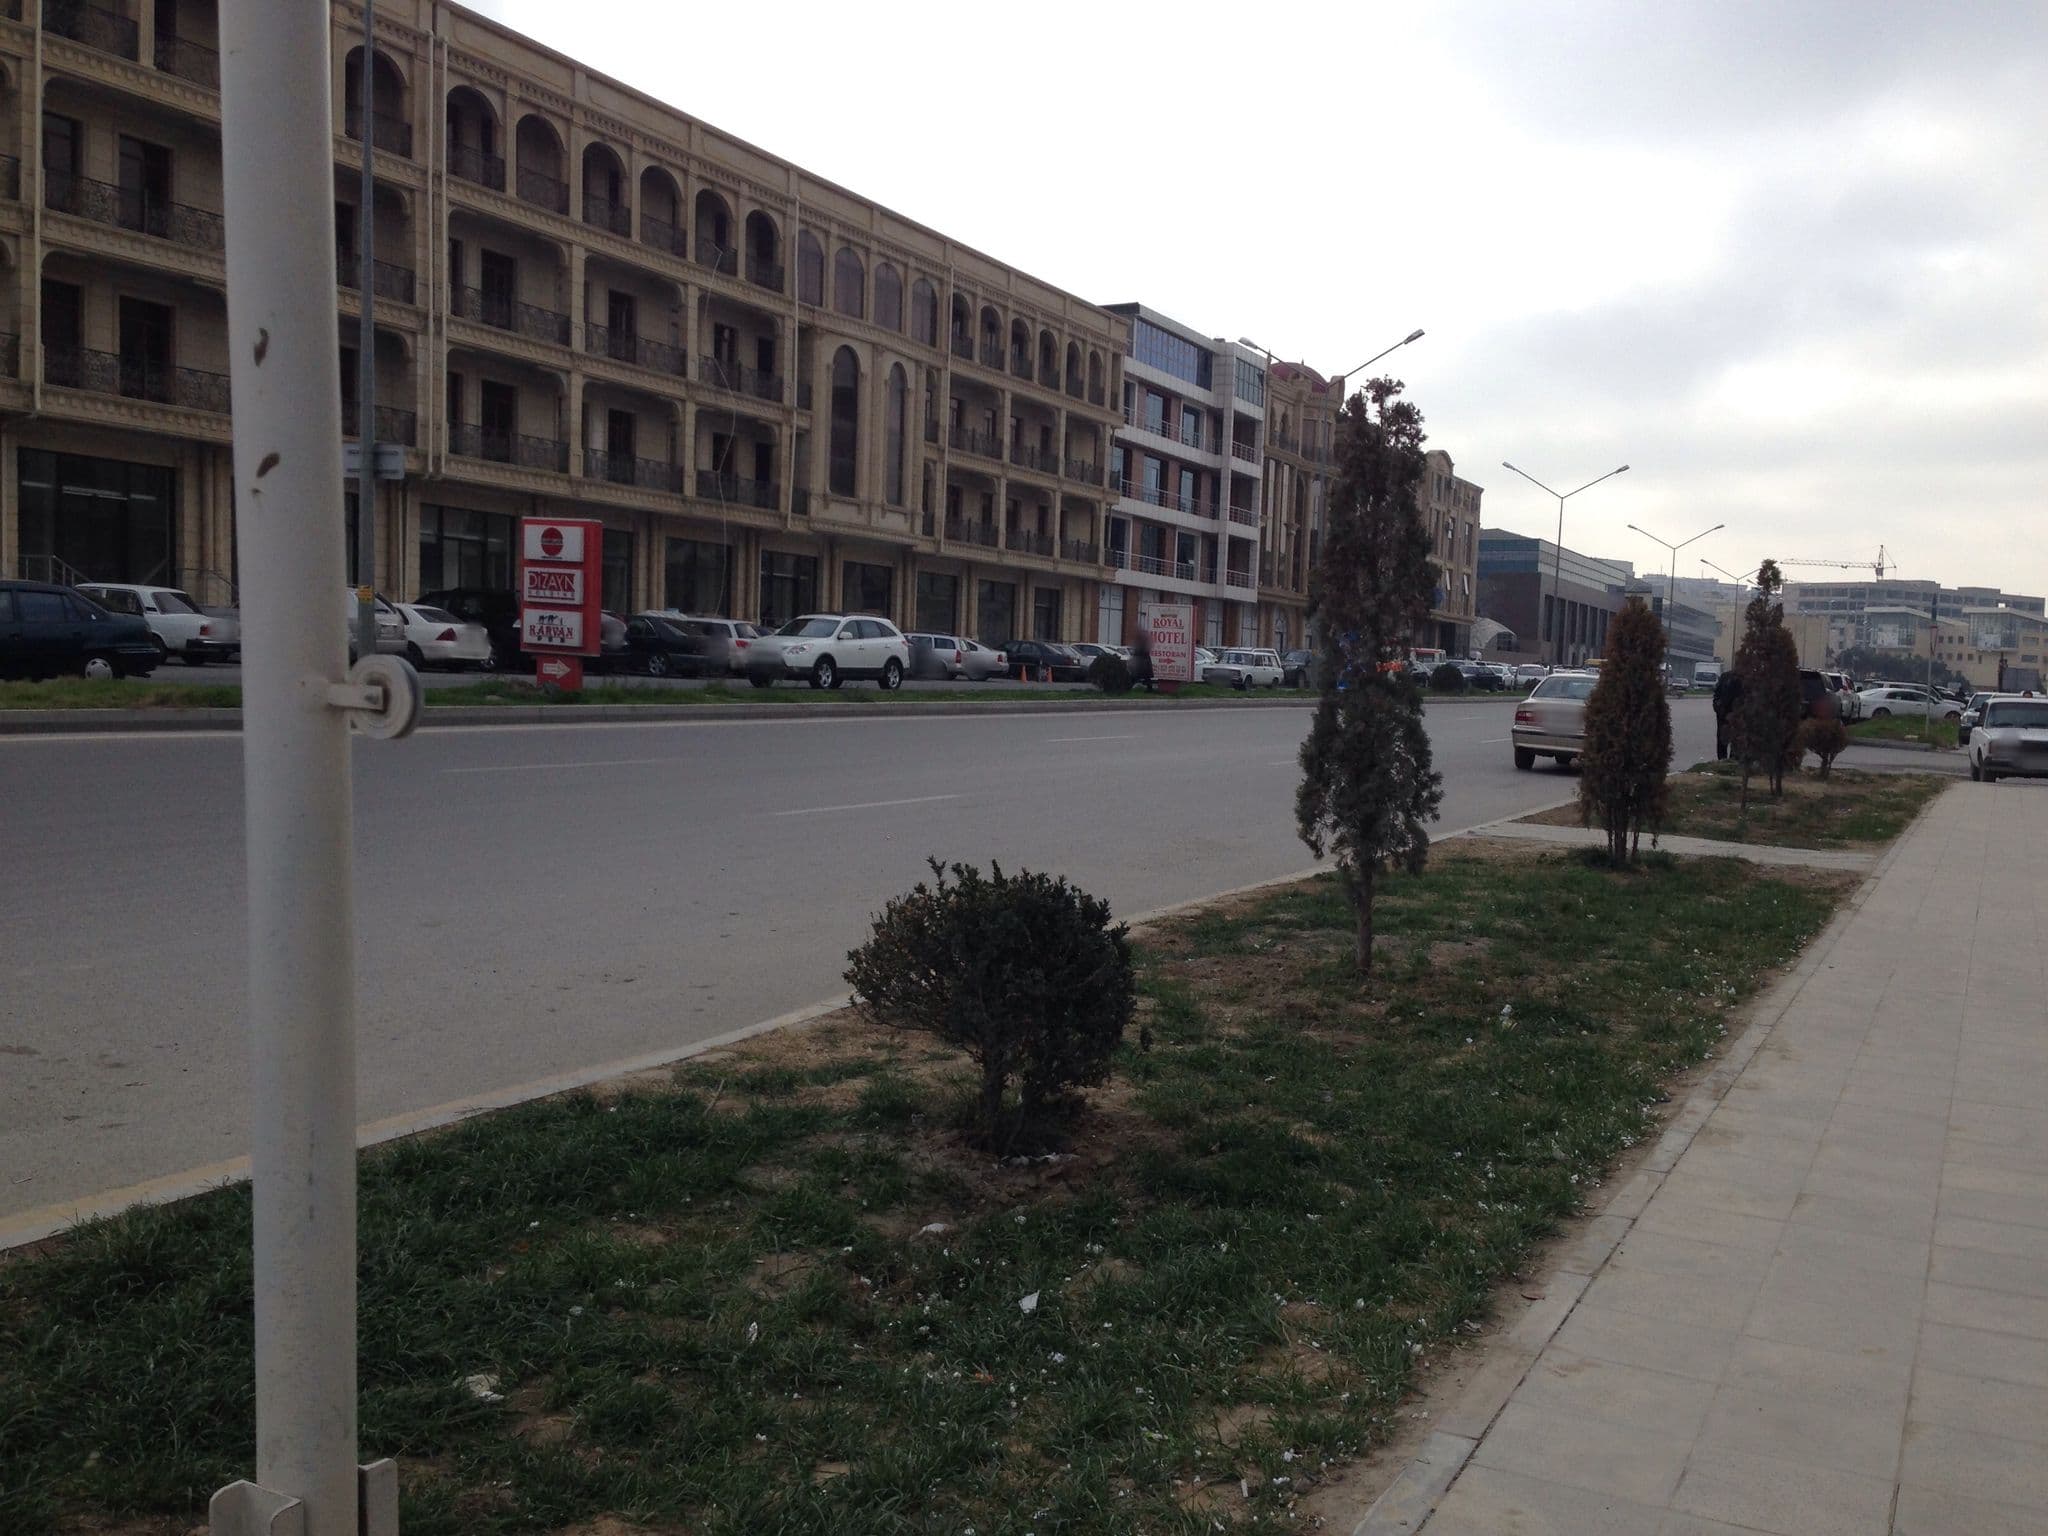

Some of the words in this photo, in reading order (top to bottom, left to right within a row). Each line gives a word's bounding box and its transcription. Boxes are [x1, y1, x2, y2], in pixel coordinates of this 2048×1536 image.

[528, 573, 576, 592] DIZAYN
[1153, 618, 1184, 628] ROYAL
[529, 625, 574, 639] KARVAN
[1151, 631, 1187, 644] HOTEL
